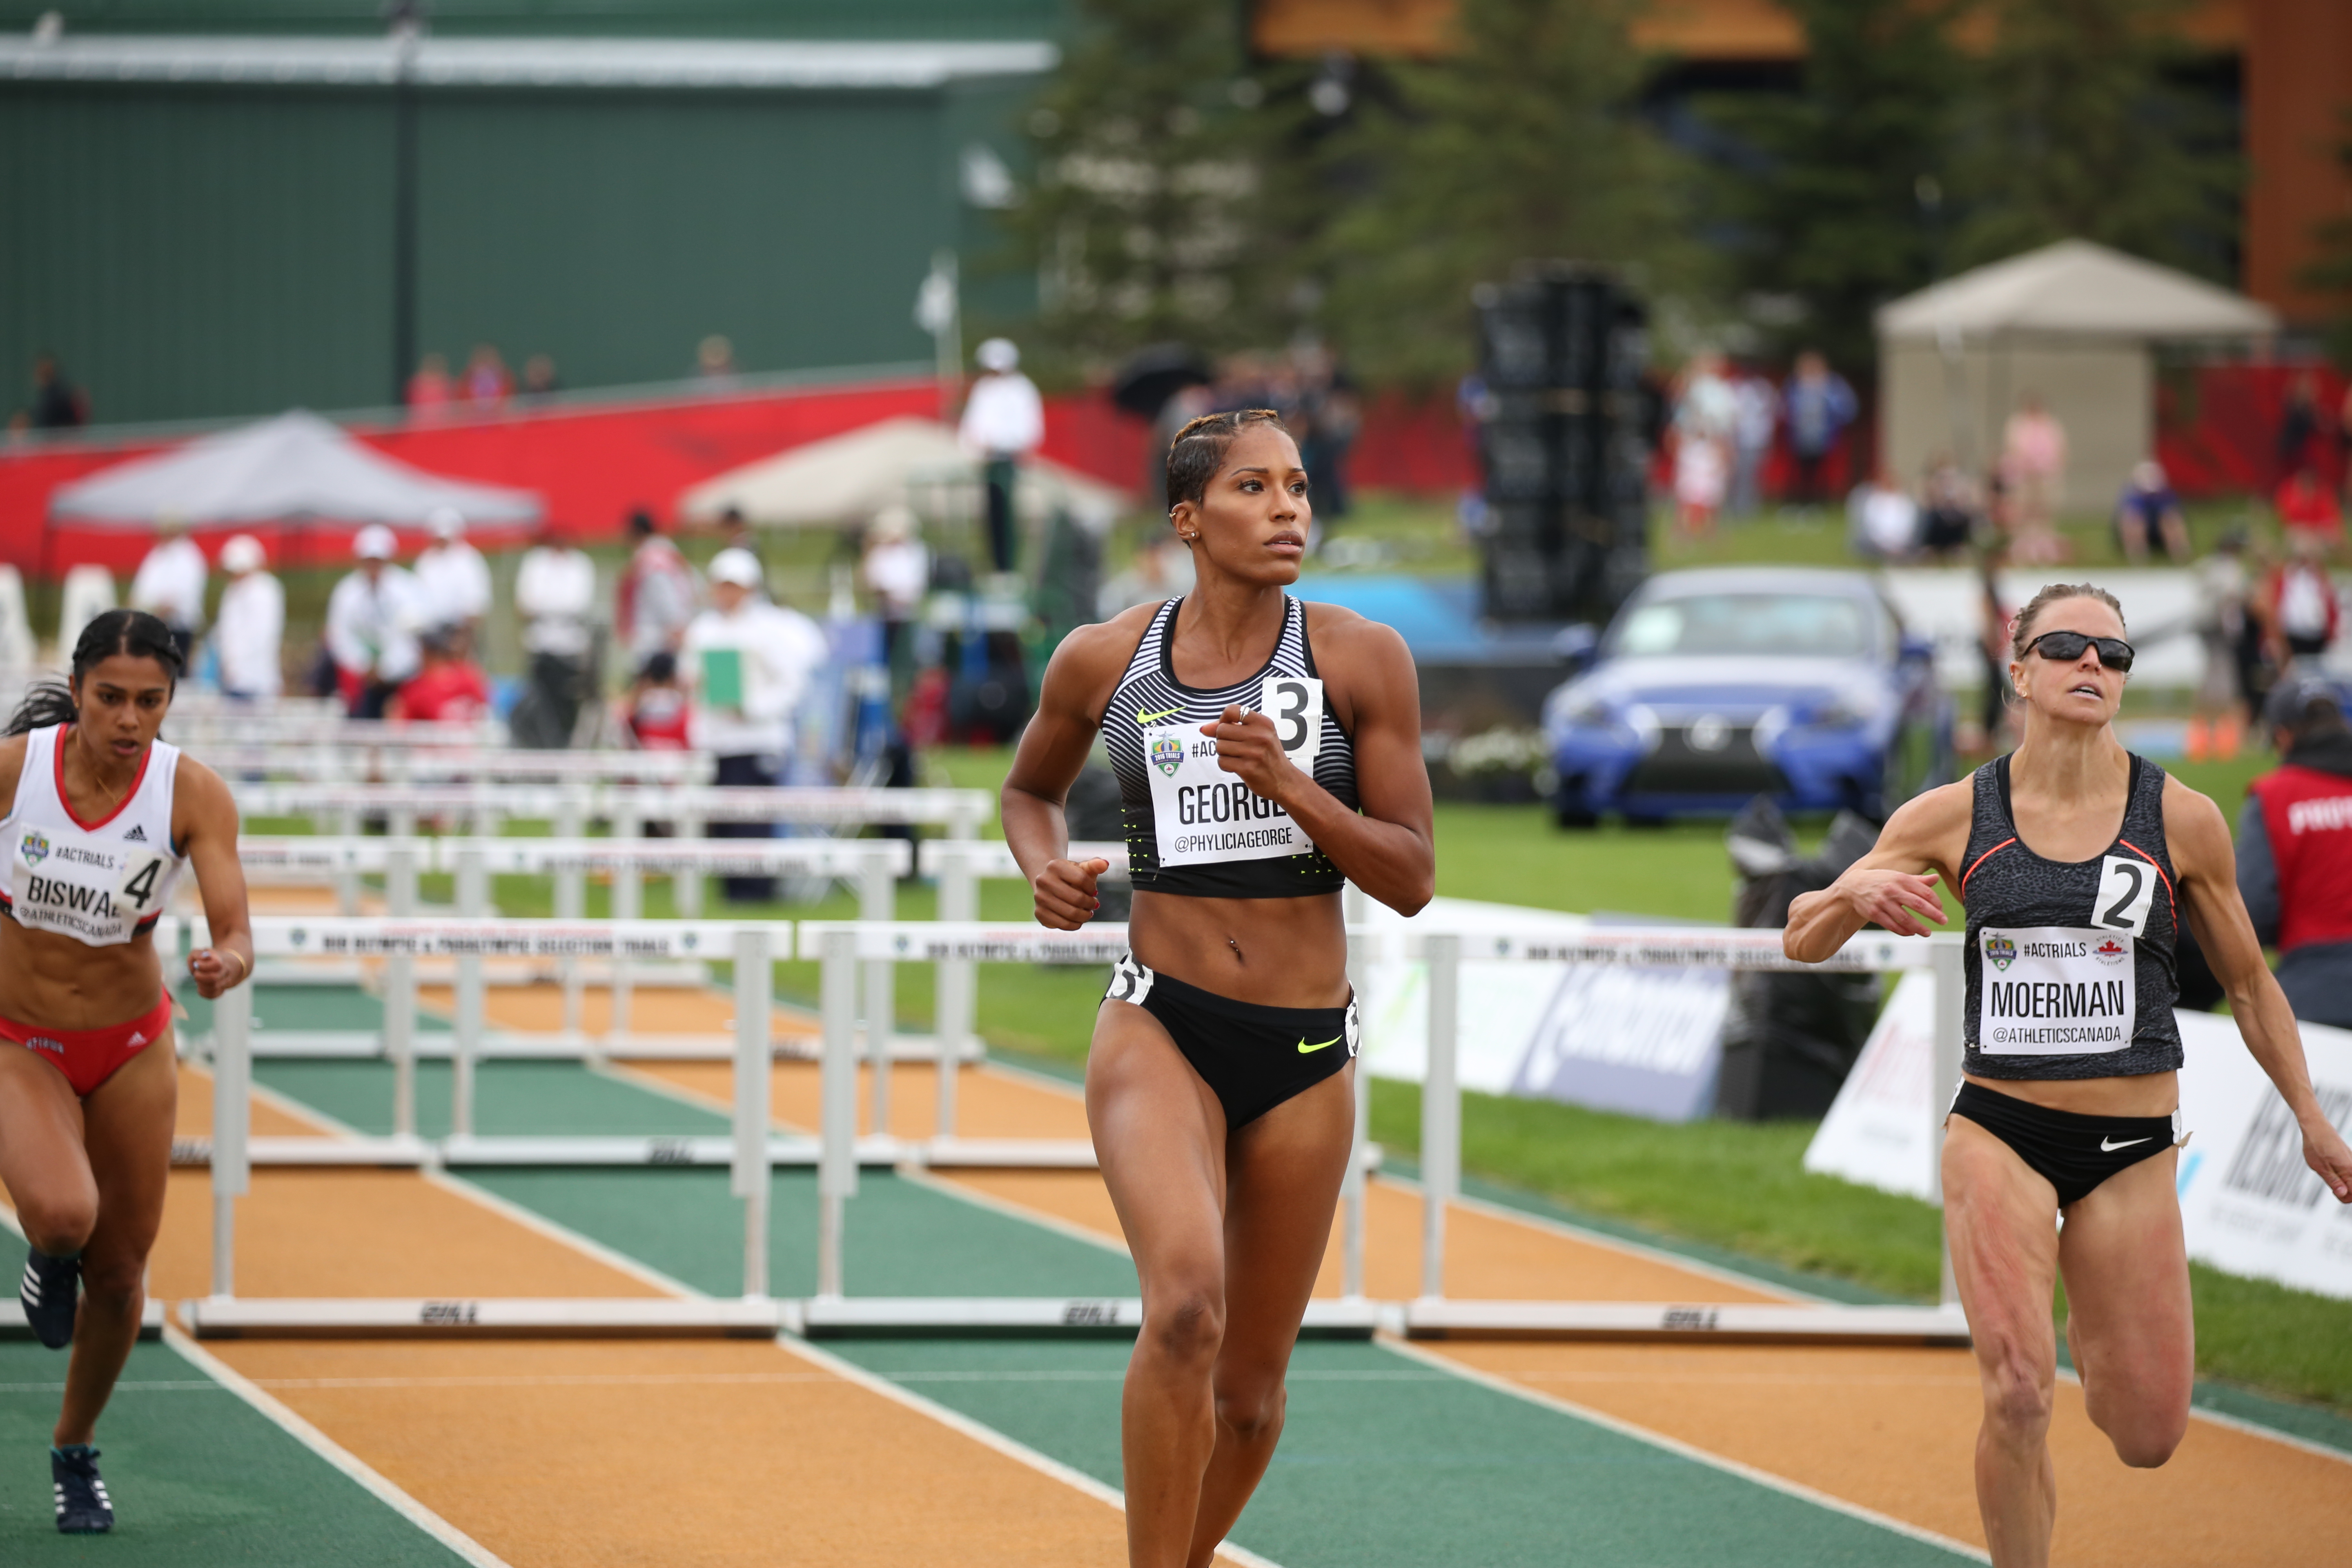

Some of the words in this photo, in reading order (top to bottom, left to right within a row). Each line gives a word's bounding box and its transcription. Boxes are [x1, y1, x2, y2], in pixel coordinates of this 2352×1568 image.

[1277, 682, 1308, 751] 3
[1175, 827, 1292, 853] @PHYLICIAGEORGE
[56, 846, 114, 869] #ACTRIALS
[124, 858, 161, 909] 4
[2103, 864, 2142, 928] 2
[2024, 942, 2087, 958] #ACTRIALS
[1991, 980, 2124, 1018] MOERMAN
[1993, 1026, 2121, 1043] @ATHLETICSCANADA
